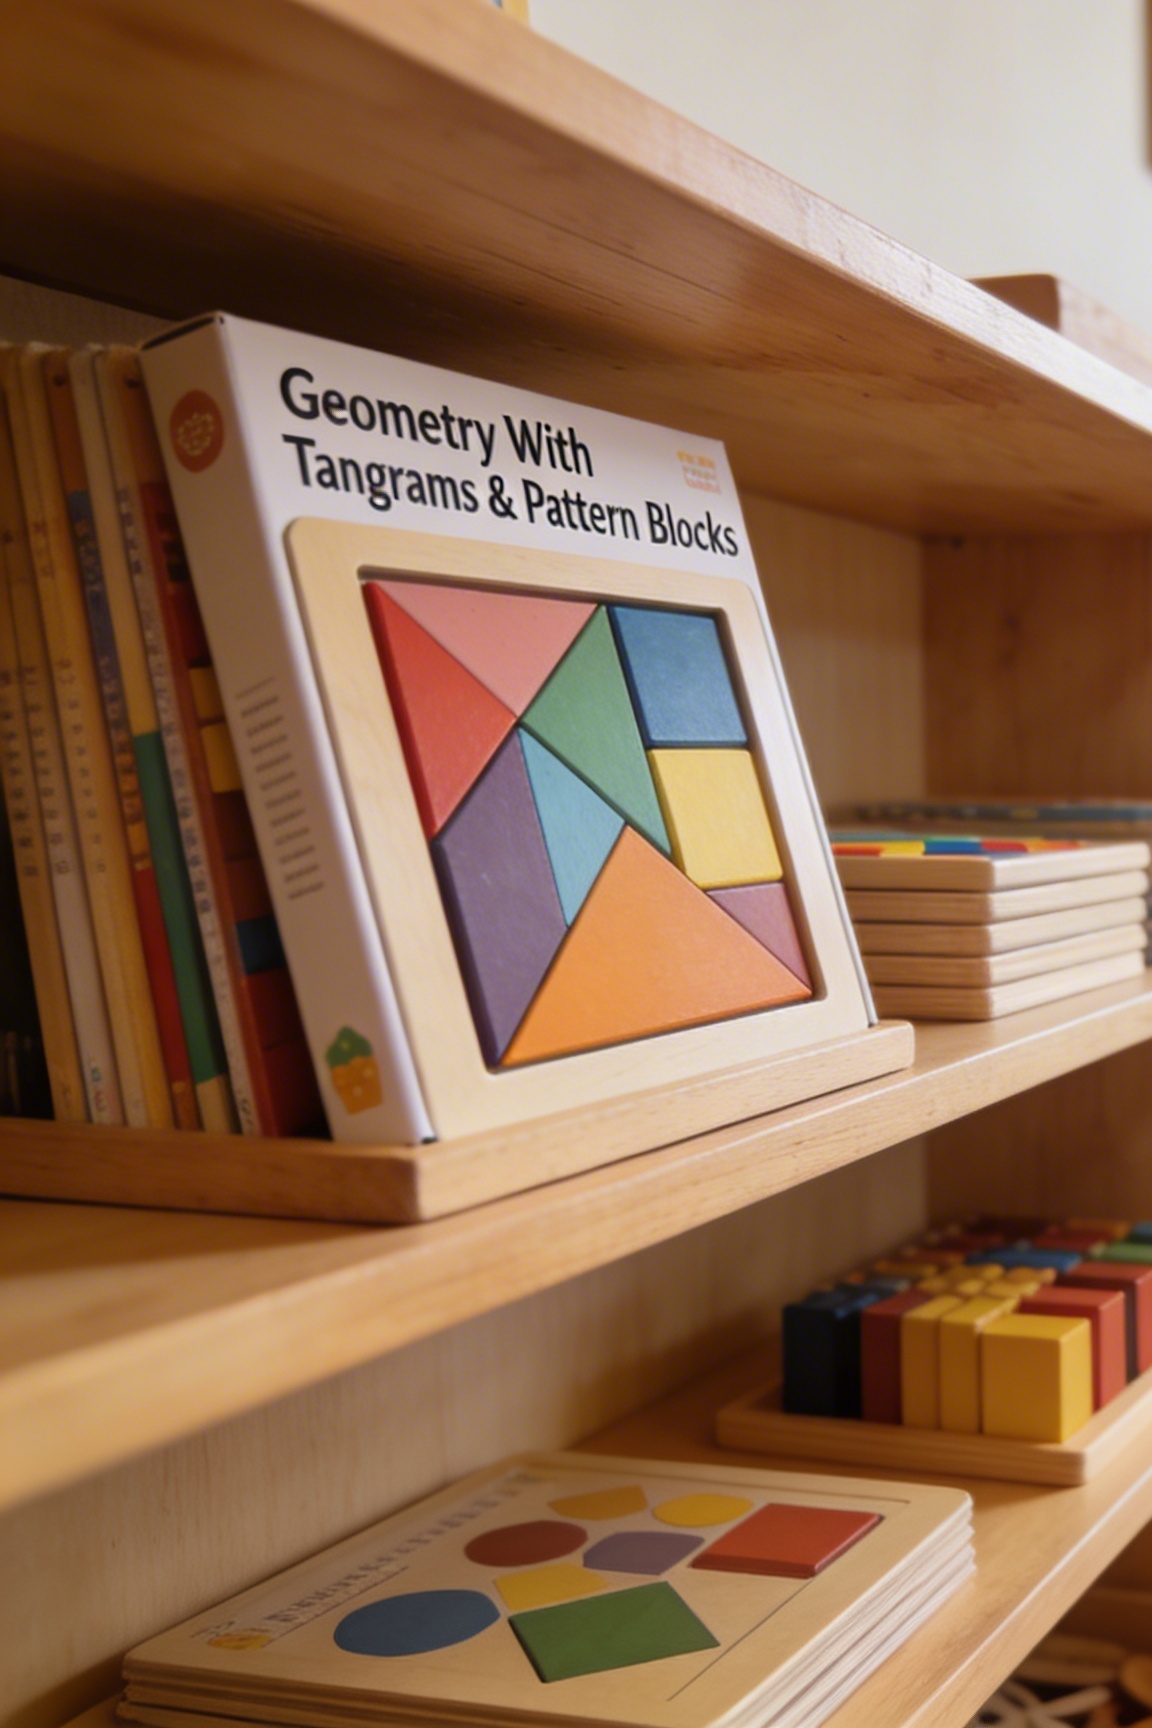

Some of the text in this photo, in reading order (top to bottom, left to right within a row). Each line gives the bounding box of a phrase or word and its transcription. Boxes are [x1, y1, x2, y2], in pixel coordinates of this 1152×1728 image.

[279, 367, 594, 477] Geometry With
[282, 434, 739, 557] Tangrams & Pattern Blocks
